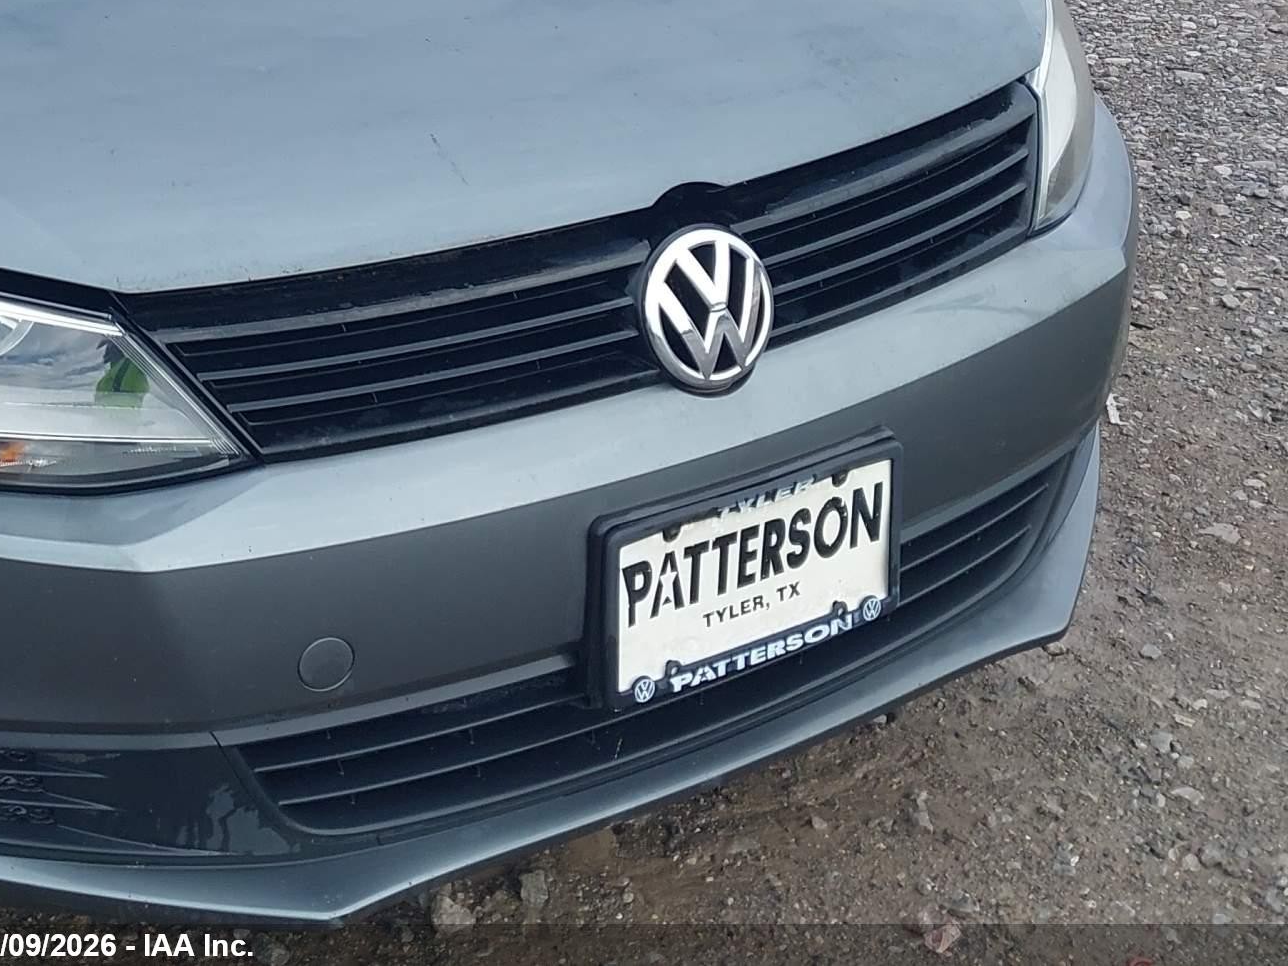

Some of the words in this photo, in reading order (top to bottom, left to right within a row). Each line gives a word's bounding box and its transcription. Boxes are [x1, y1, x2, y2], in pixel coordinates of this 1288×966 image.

[621, 481, 884, 628] PATTERSON
[702, 594, 770, 627] TYLER,
[776, 581, 801, 602] TX
[669, 613, 853, 693] PATTERSON
